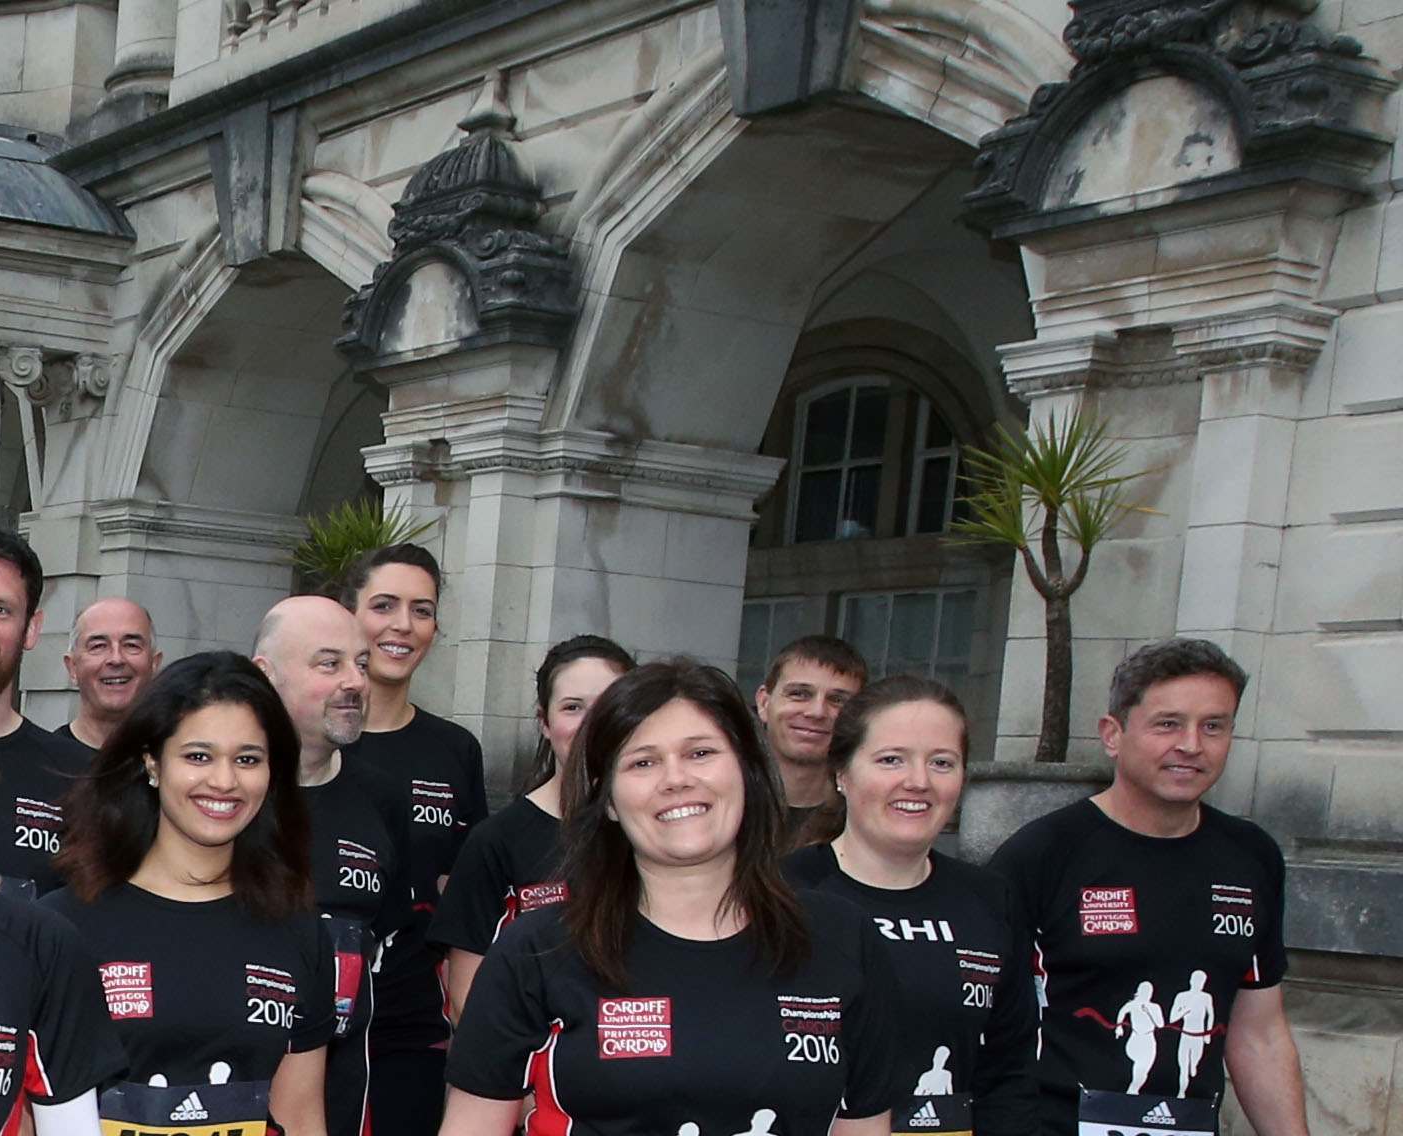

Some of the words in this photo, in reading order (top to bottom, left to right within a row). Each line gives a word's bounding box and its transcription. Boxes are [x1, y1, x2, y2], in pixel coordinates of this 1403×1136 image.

[412, 804, 453, 827] 2016
[14, 825, 60, 854] 2016
[339, 866, 381, 893] 2016
[1082, 890, 1131, 903] CARDIFF
[1212, 913, 1255, 938] 2016
[247, 997, 295, 1029] 2016
[602, 1000, 666, 1016] CARDIFF
[780, 1008, 841, 1021] Championships
[604, 1015, 665, 1023] UNIVERSITY
[604, 1030, 665, 1038] PRIFYSGOL
[784, 1033, 840, 1065] 2016
[169, 1109, 209, 1121] adidas
[1142, 1115, 1176, 1125] adidas
[908, 1118, 941, 1127] adidas
